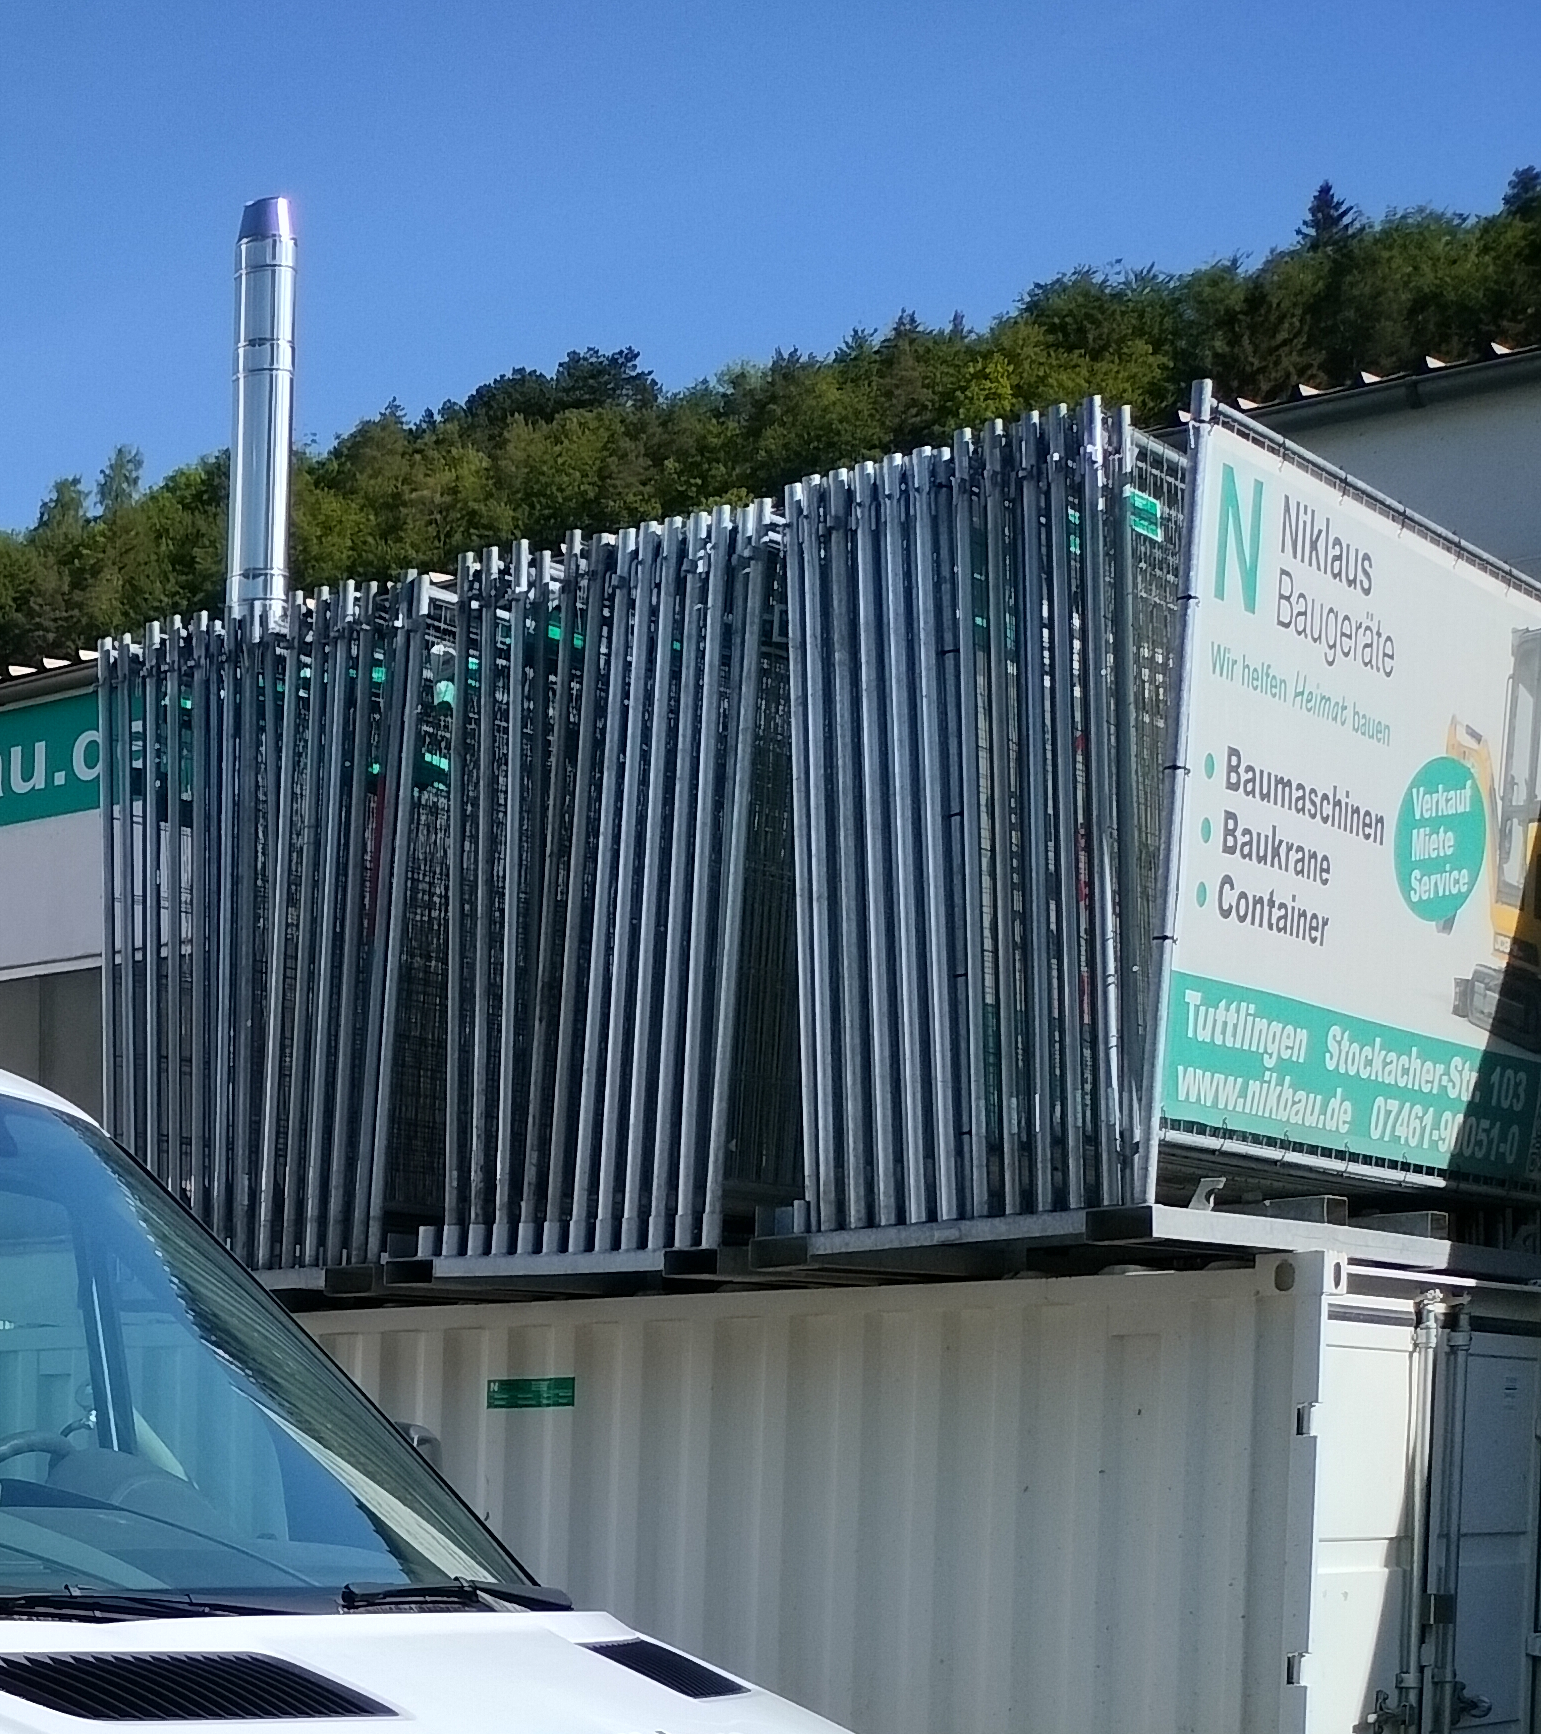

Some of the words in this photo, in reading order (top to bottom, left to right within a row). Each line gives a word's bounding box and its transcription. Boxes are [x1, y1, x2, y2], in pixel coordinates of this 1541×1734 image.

[1214, 463, 1264, 614] N
[1281, 494, 1373, 596] Niklaus
[1277, 567, 1395, 677] Baugeräte
[1211, 641, 1237, 682] Wir
[1242, 655, 1287, 703] helfen
[1293, 670, 1347, 727] Heimat
[1352, 703, 1391, 746] bauen
[1225, 746, 1385, 845] Baumaschinen
[1411, 828, 1454, 861] Miete
[1412, 780, 1471, 819] Verkauf
[1222, 810, 1331, 886] Baukrane
[1410, 866, 1468, 902] Service
[1218, 874, 1329, 946] Container
[1185, 990, 1307, 1067] Tuttlingen
[1325, 1025, 1480, 1103] Stockacher-Str.
[1490, 1066, 1527, 1111] 103
[1177, 1065, 1351, 1133] www.nikbau.de
[1370, 1096, 1519, 1163] 07461-90051-0
